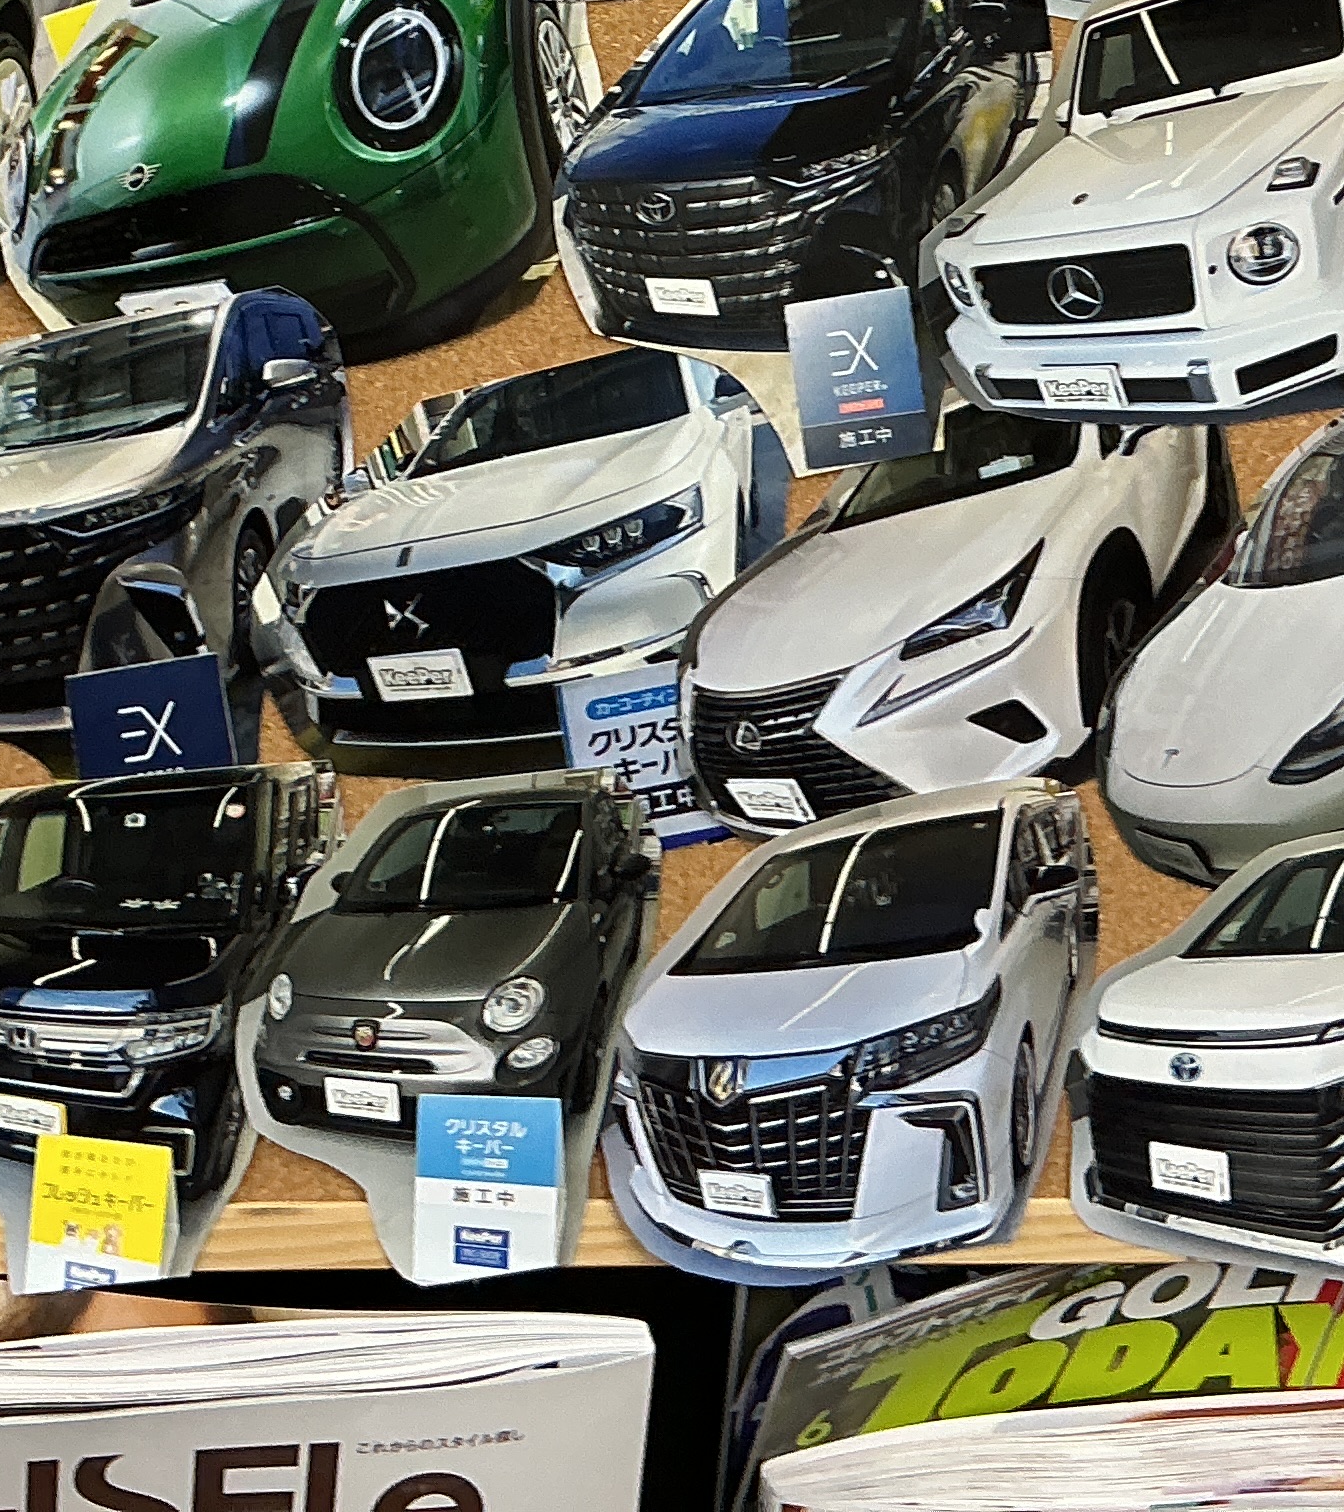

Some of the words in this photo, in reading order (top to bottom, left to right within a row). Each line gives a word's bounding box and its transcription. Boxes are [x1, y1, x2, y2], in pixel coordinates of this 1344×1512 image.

[1044, 379, 1110, 398] KeePer
[379, 667, 452, 687] KeePer
[797, 1409, 832, 1446] 6
